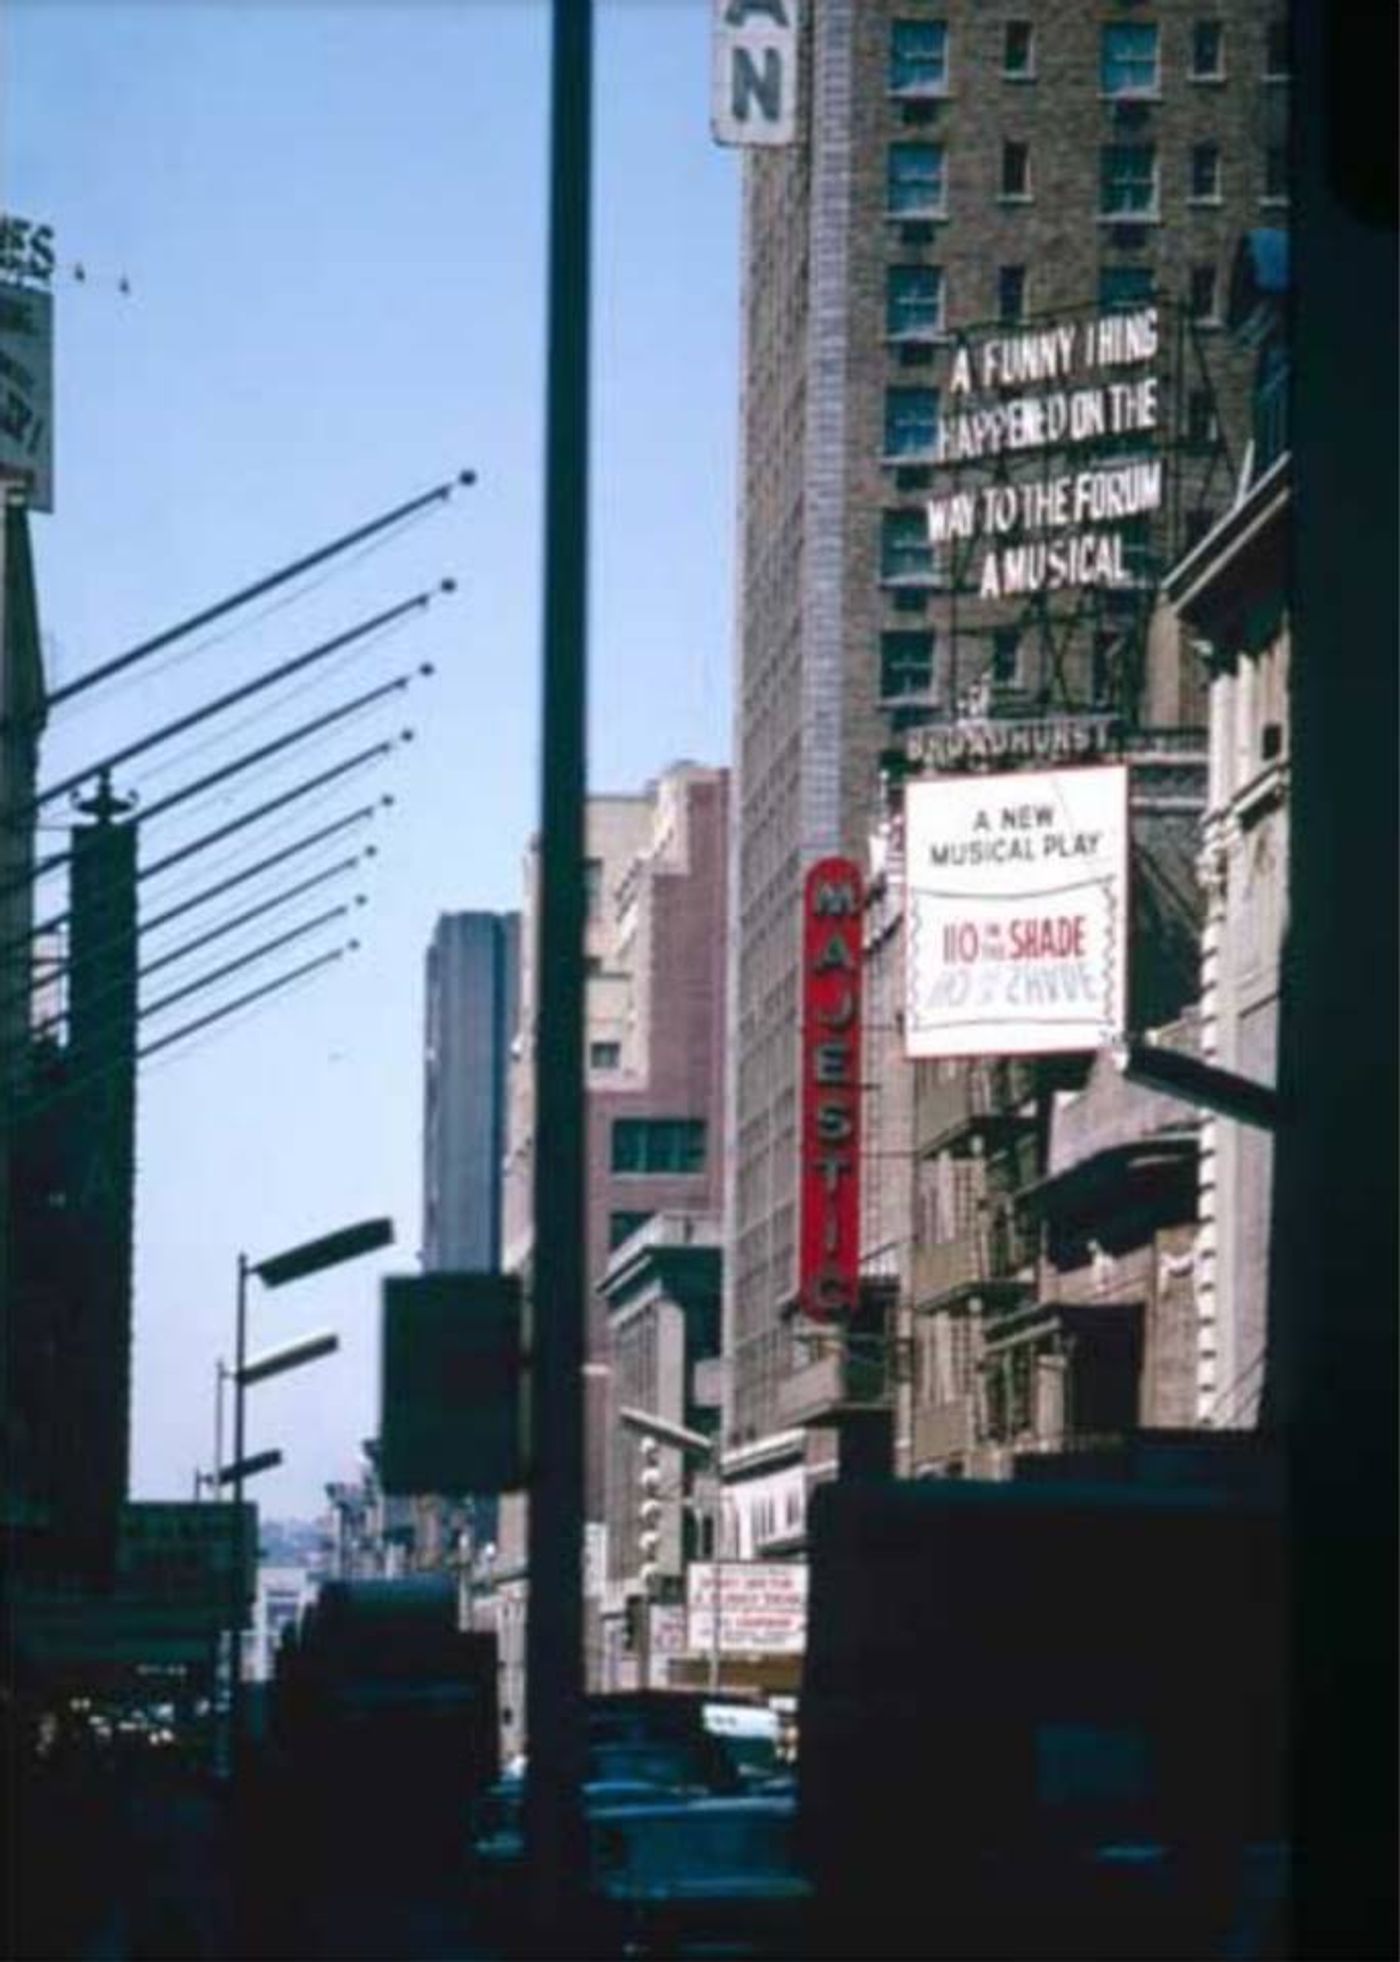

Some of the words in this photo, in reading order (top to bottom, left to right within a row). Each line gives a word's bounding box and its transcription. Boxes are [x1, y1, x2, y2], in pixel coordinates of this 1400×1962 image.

[951, 348, 971, 393] A
[982, 324, 1076, 387] FUNNY
[1085, 307, 1158, 367] THING
[1070, 389, 1105, 441] ON
[1110, 376, 1158, 433] THE
[928, 492, 975, 543] WAY
[982, 486, 1017, 532] TO
[1020, 476, 1072, 530] THE
[1073, 461, 1162, 522] FORUM
[980, 551, 1000, 598] A
[1003, 533, 1130, 591] MUSICAL
[930, 837, 1035, 866] MUSICAL
[1043, 832, 1101, 859] PLAY
[972, 810, 992, 832] A
[1001, 803, 1055, 831] NEW
[1008, 915, 1086, 959] SHADE
[812, 882, 857, 1309] MAJESTIC
